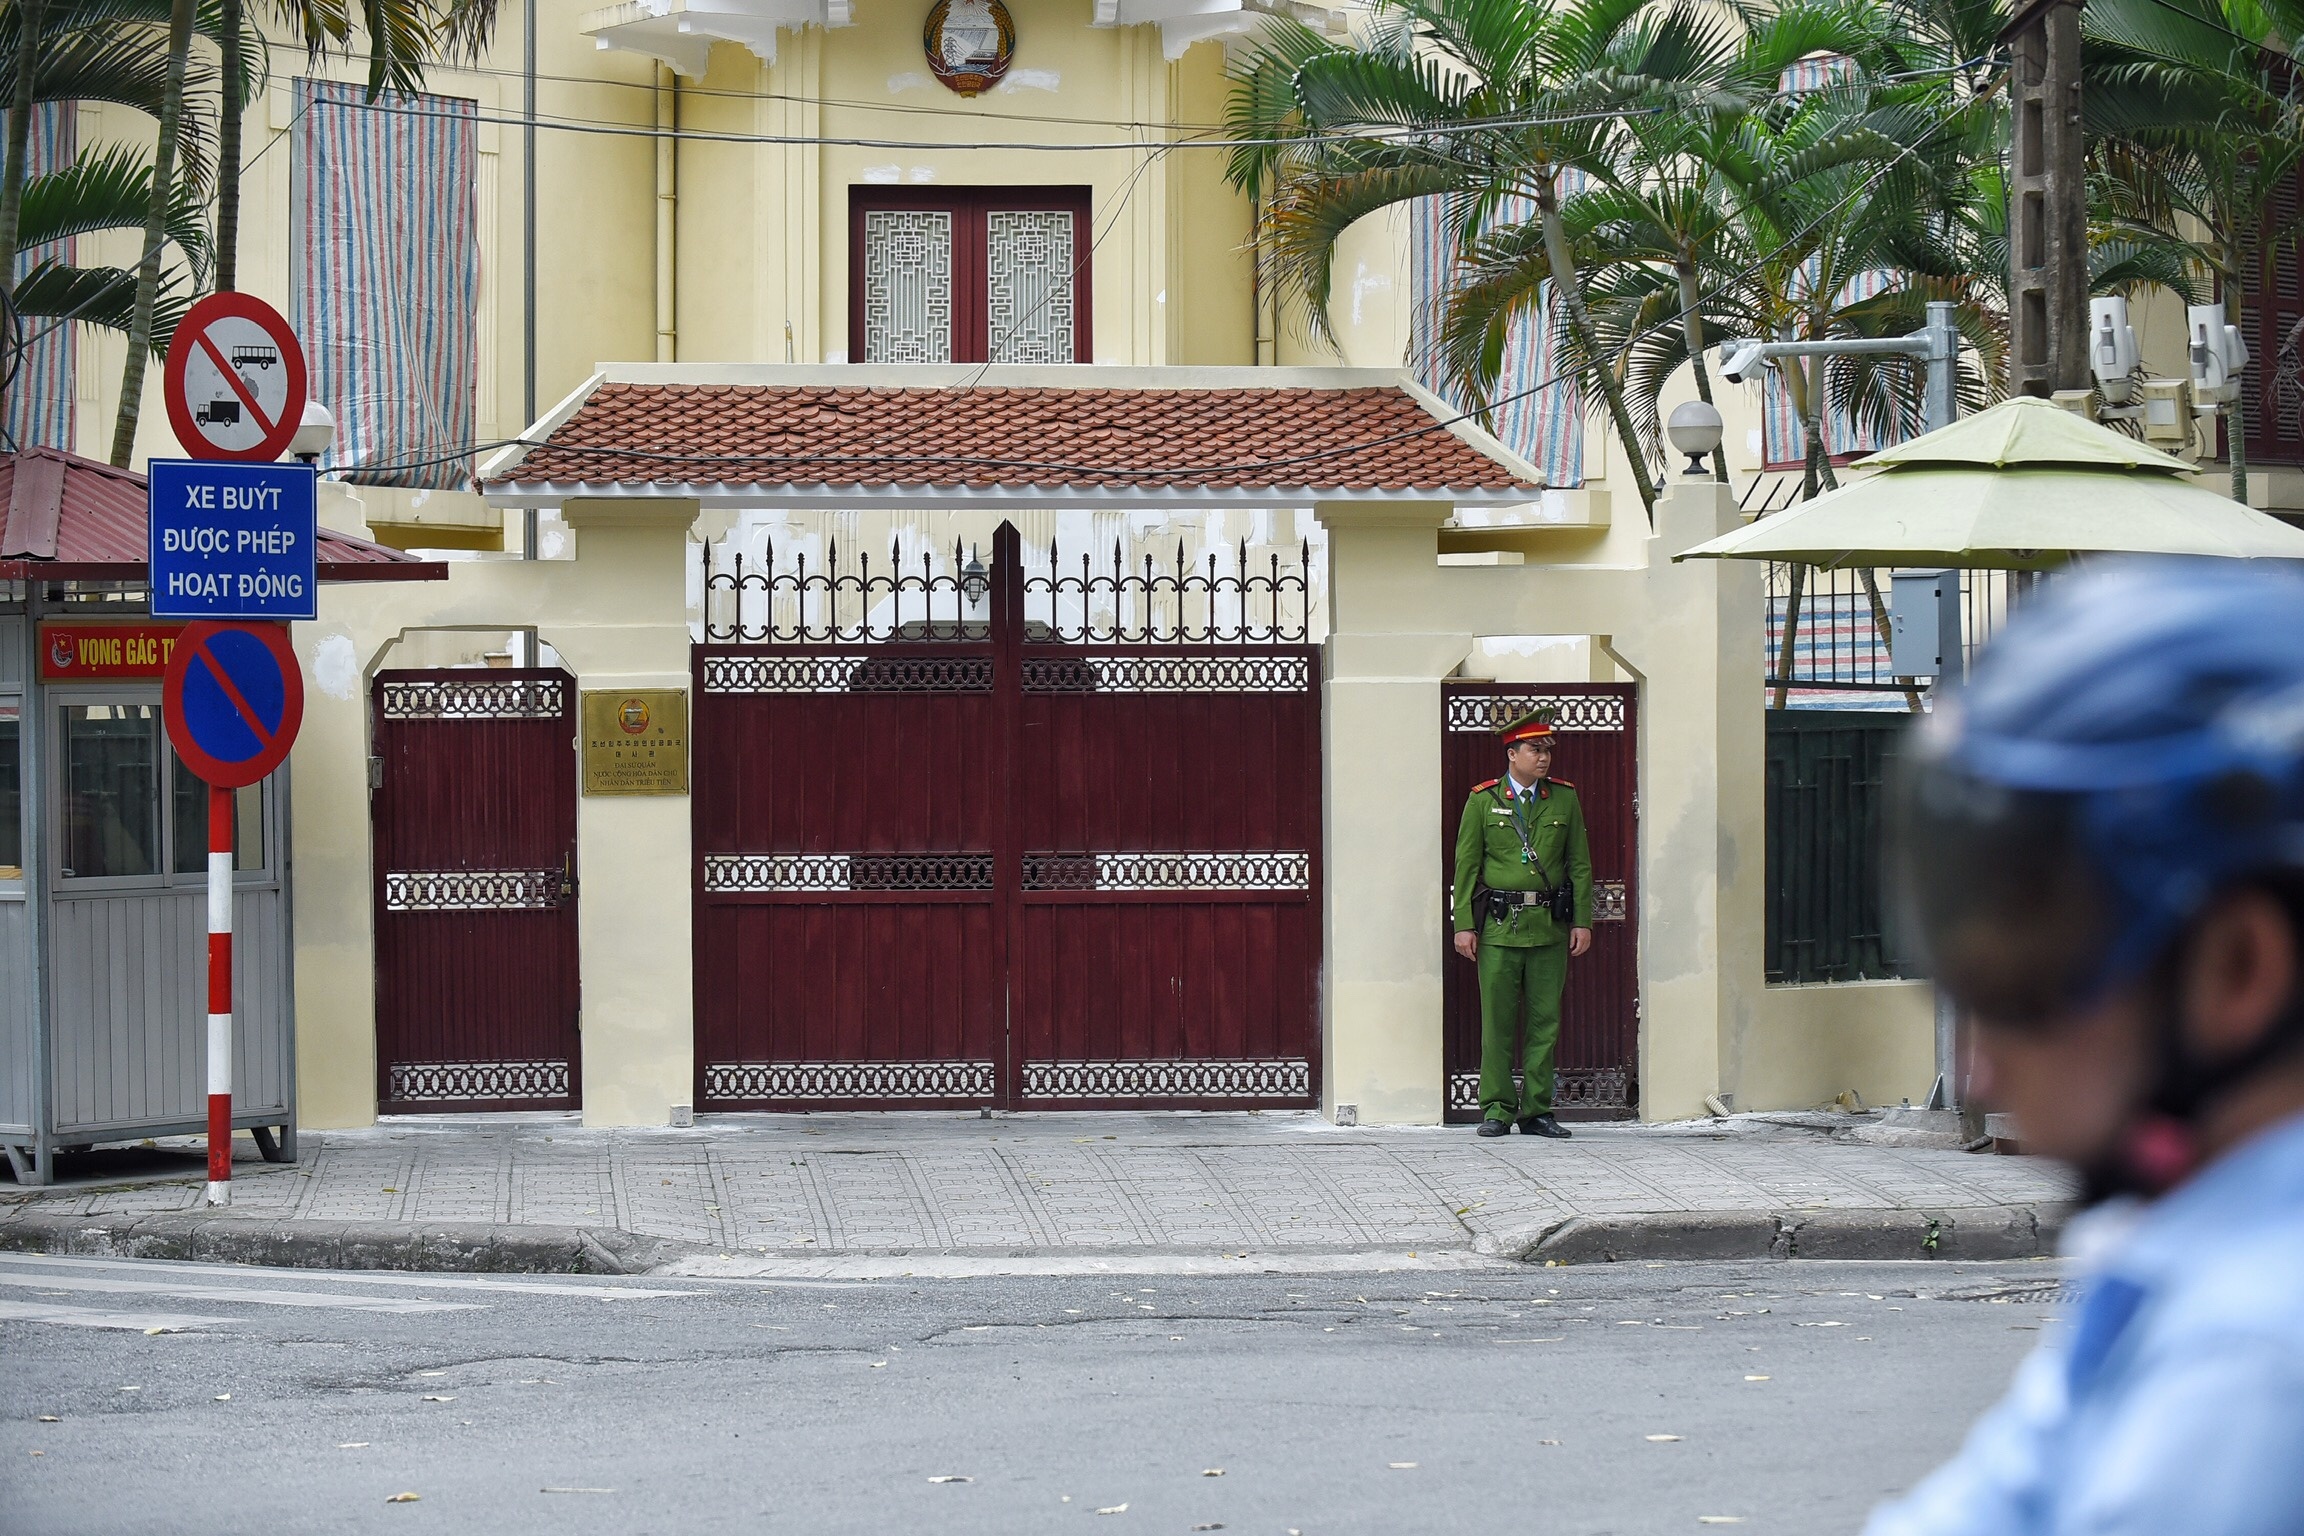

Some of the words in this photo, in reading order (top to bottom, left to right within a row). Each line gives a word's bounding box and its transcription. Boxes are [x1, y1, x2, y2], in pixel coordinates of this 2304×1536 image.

[185, 484, 215, 509] XE
[223, 480, 282, 511] BUÝT
[163, 525, 230, 559] ĐƯỢC
[237, 523, 295, 554] PHÉP
[169, 572, 232, 604] HOẠT
[238, 567, 303, 605] ĐỘNG
[78, 638, 122, 671] VỌNG
[126, 632, 157, 665] GÁC
